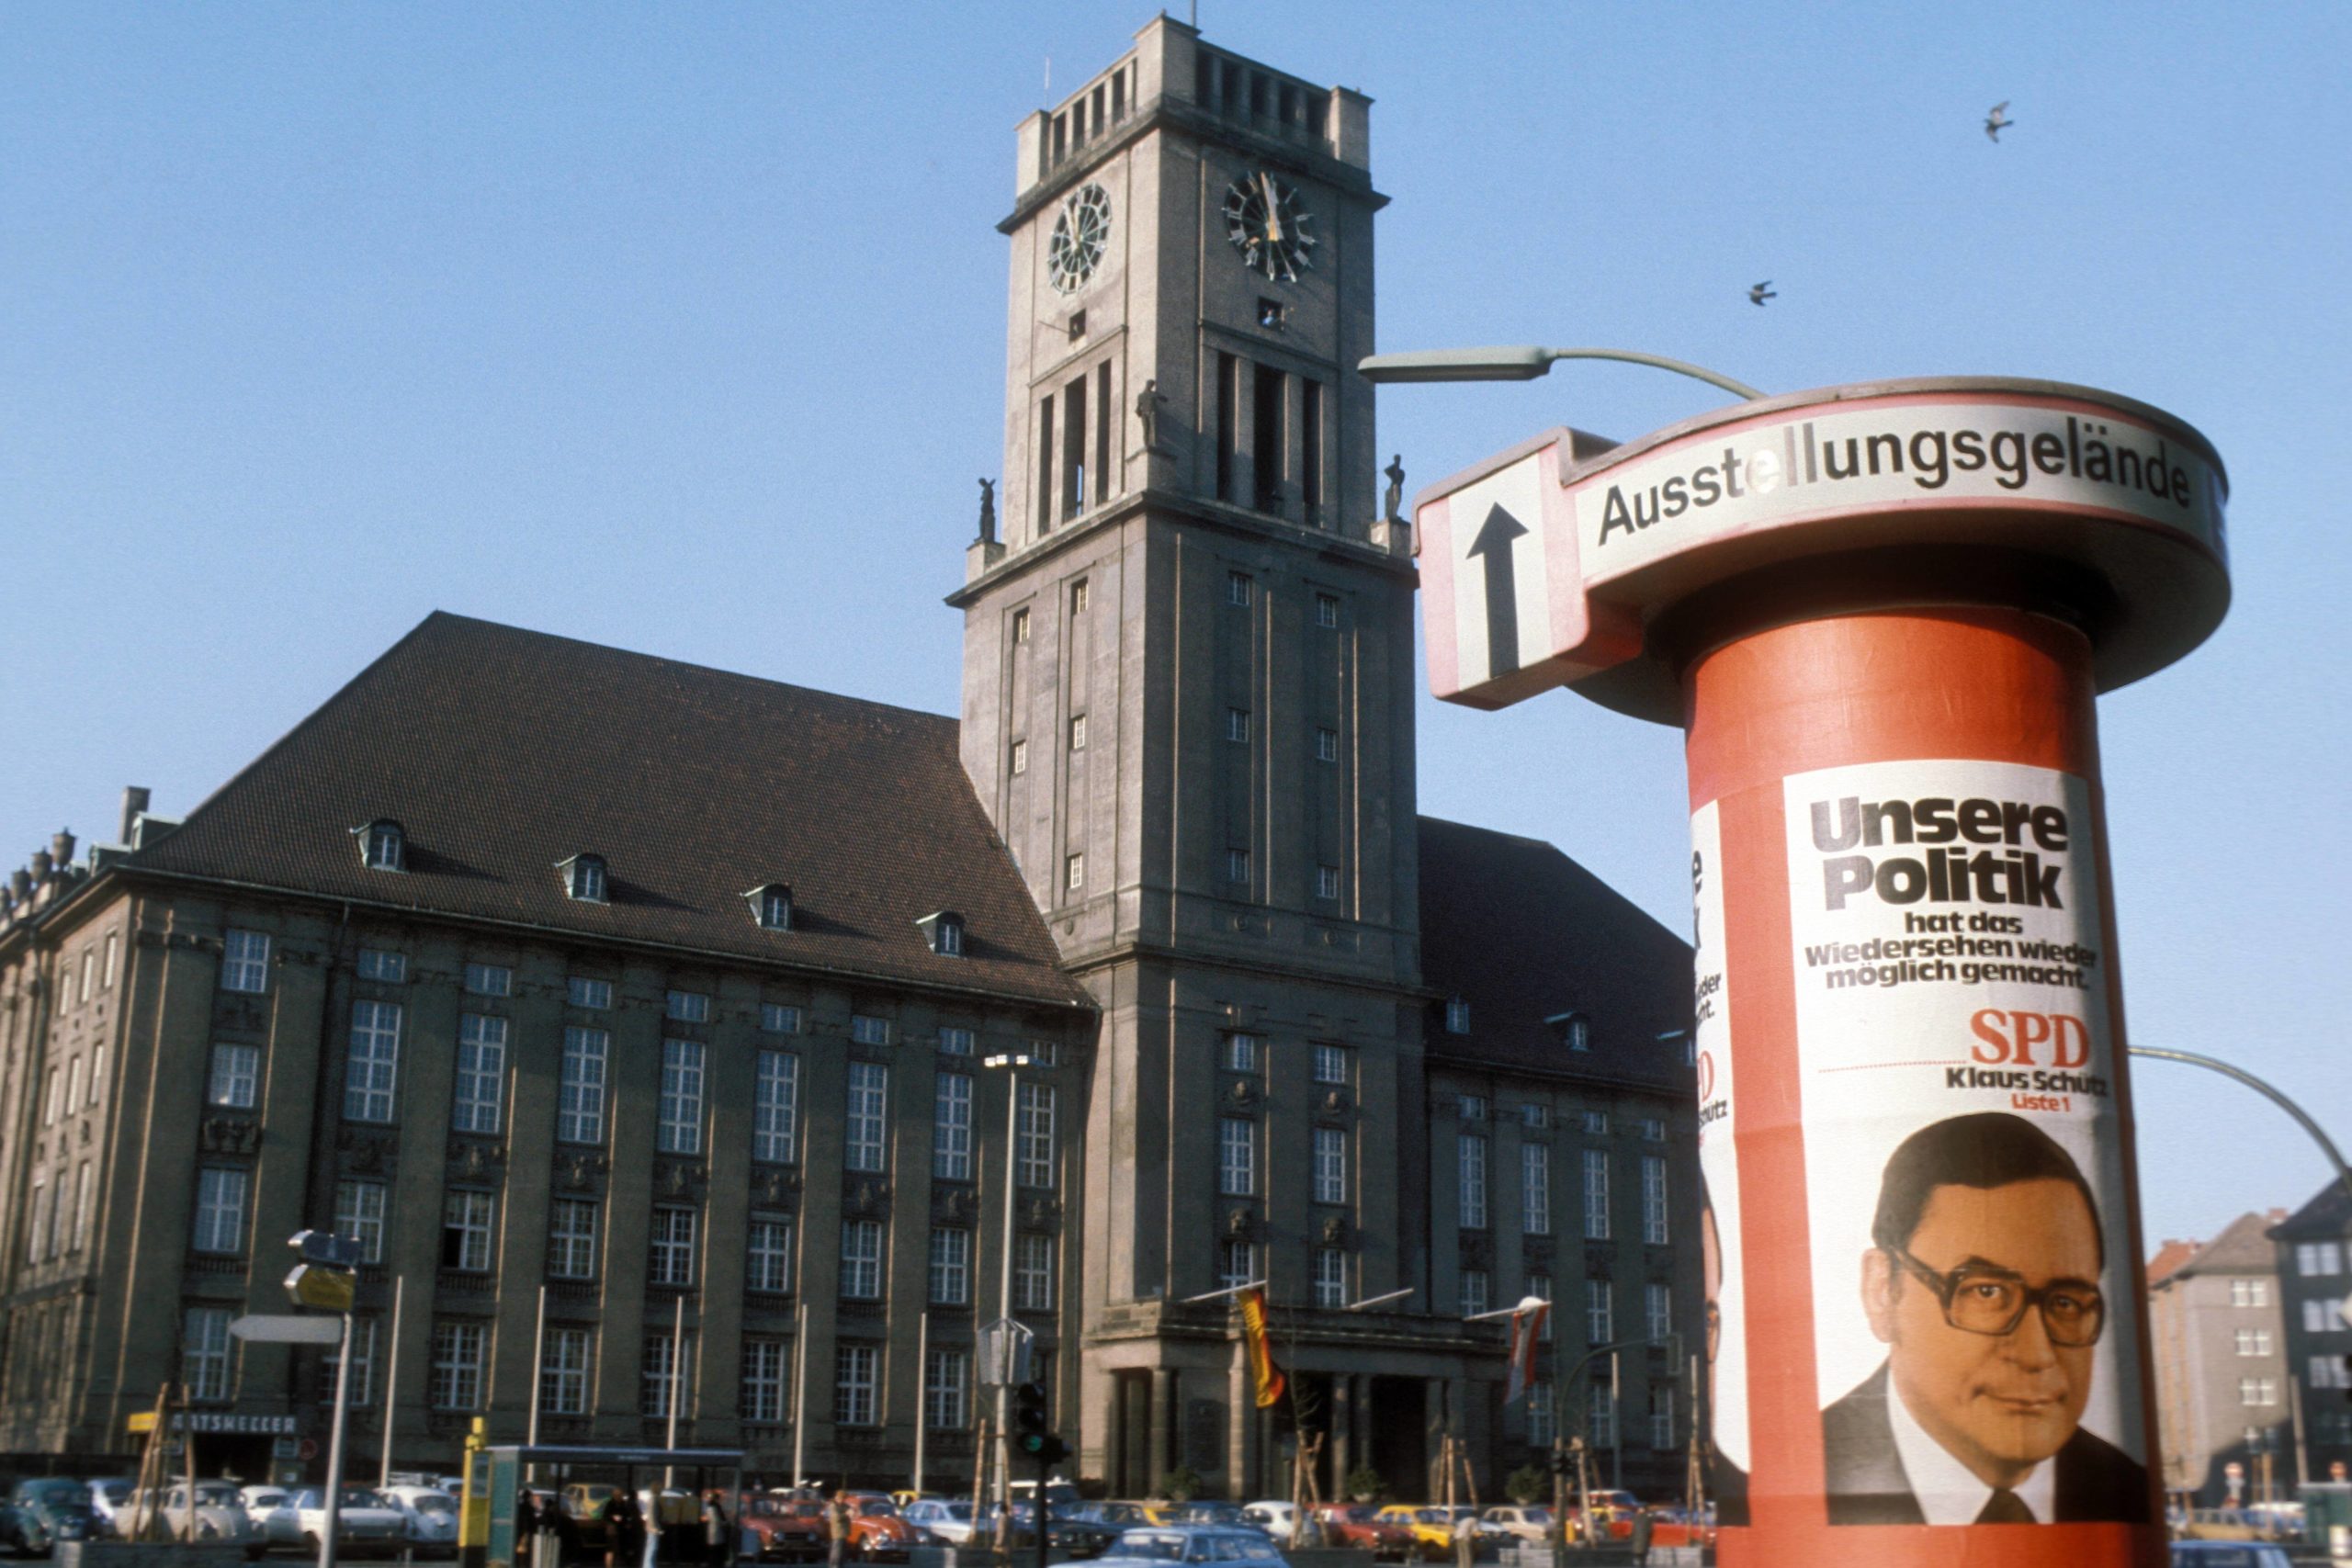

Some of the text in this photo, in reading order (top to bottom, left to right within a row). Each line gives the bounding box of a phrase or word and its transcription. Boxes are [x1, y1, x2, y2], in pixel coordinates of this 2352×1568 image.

[1599, 417, 2190, 547] Ausstellungsgelände
[1810, 796, 2068, 852] Unsere
[1823, 847, 2064, 910] Politik
[1905, 911, 2023, 934] hat das
[1805, 935, 2096, 967] Wiedersehen wieder
[1826, 959, 2088, 990] möglich gemacht.
[1970, 1009, 2089, 1069] SPD
[1946, 1066, 2029, 1089] Klaus
[2011, 1093, 2071, 1112] Liste 1
